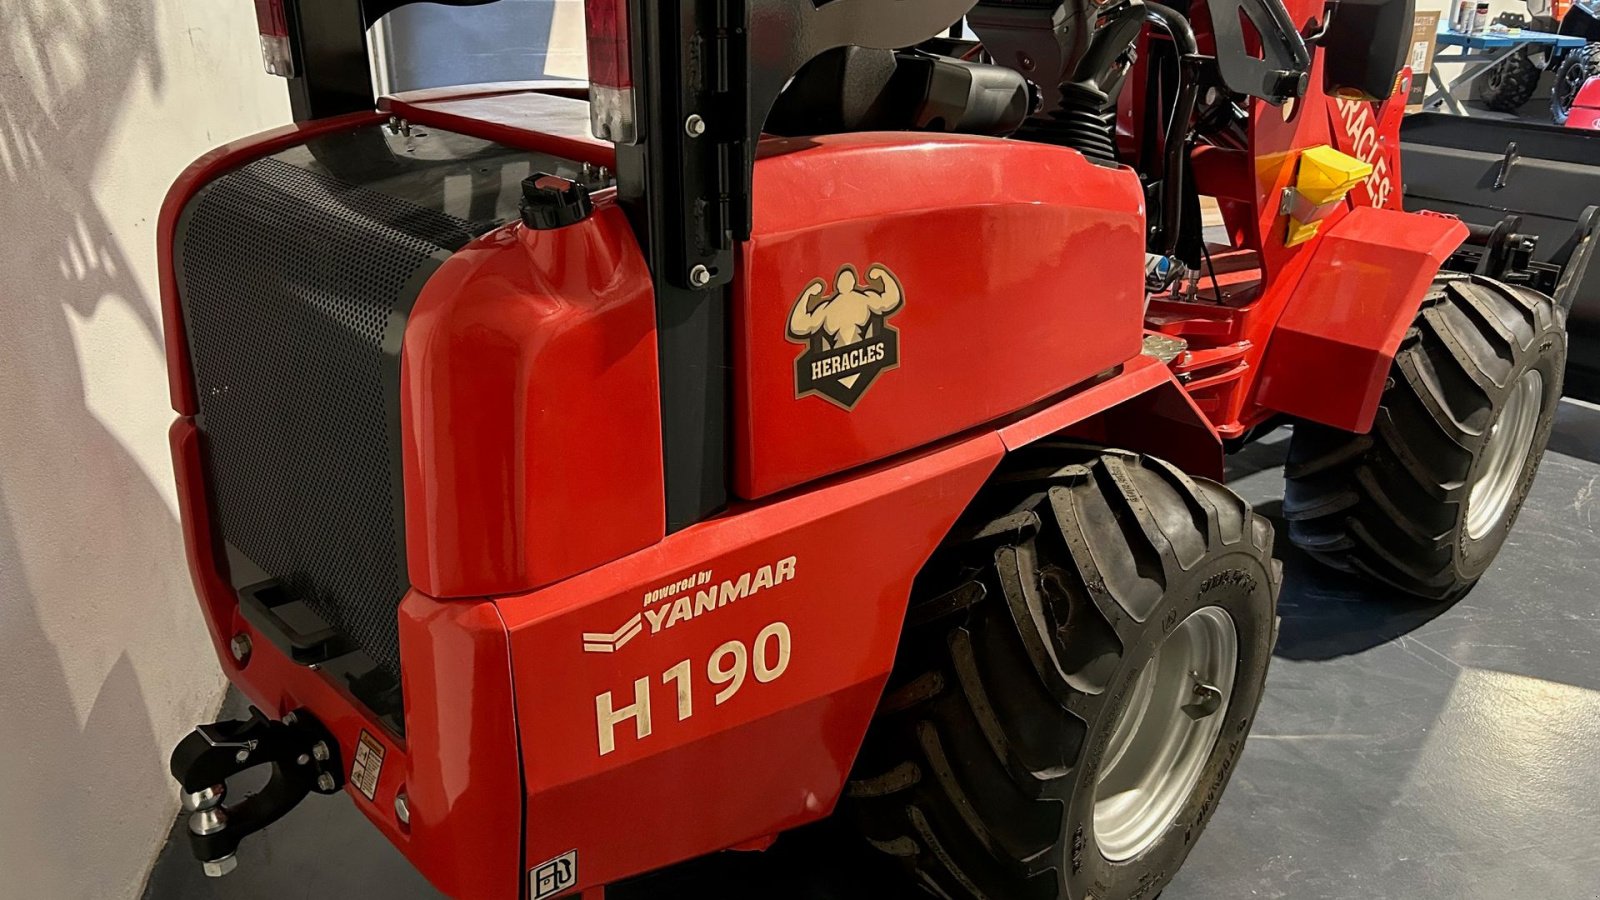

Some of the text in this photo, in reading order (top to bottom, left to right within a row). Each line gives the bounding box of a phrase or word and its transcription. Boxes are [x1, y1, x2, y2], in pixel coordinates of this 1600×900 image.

[1335, 97, 1390, 209] RACLES
[811, 342, 885, 381] HERACLES
[643, 569, 712, 607] powered by
[643, 555, 797, 634] YANMAR
[595, 621, 792, 756] H190
